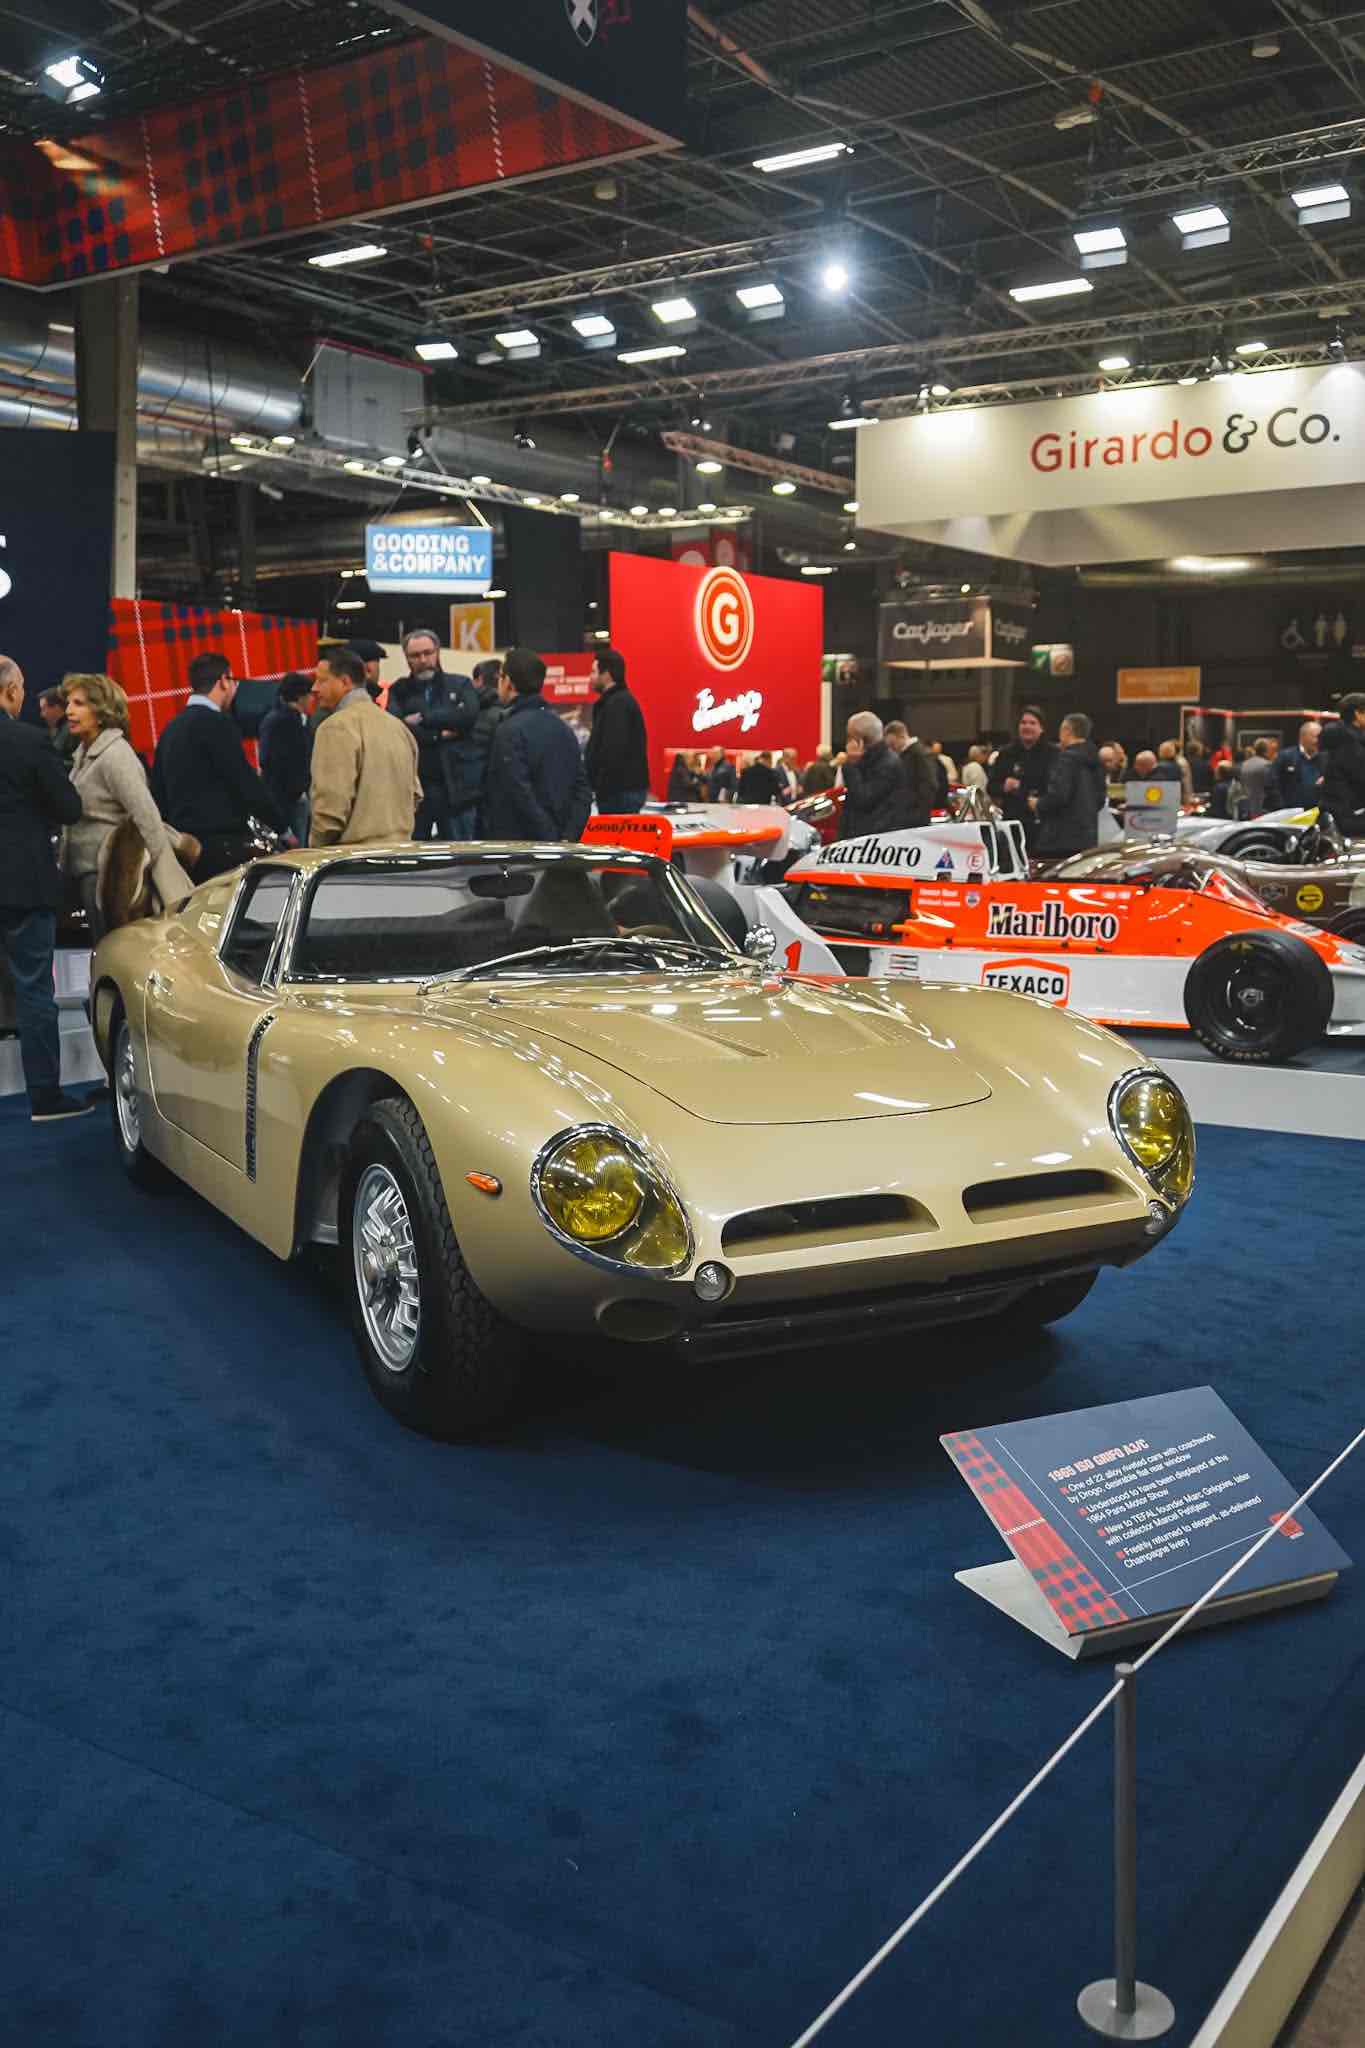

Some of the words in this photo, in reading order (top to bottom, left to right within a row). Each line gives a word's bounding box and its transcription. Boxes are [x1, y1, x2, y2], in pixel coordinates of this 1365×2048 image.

[1030, 419, 1213, 473] Girardo
[1222, 413, 1258, 454] &
[1267, 407, 1340, 448] Co.
[372, 533, 470, 553] GOODING
[372, 553, 487, 574] &COMPANY
[711, 591, 740, 646] G
[459, 618, 485, 651] K
[816, 838, 921, 868] Marlboro
[988, 902, 1118, 942] Marlboro
[986, 974, 1064, 995] TEXACO
[1085, 1476, 1095, 1486] of
[1092, 1473, 1106, 1483] 22
[1066, 1494, 1080, 1504] by
[1124, 1496, 1148, 1510] Motor
[1146, 1487, 1169, 1501] Show
[1128, 1488, 1140, 1497] to
[1122, 1519, 1134, 1528] to
[1130, 1509, 1159, 1524] TEFAL
[1180, 1524, 1192, 1533] to
[1105, 1535, 1124, 1547] with
